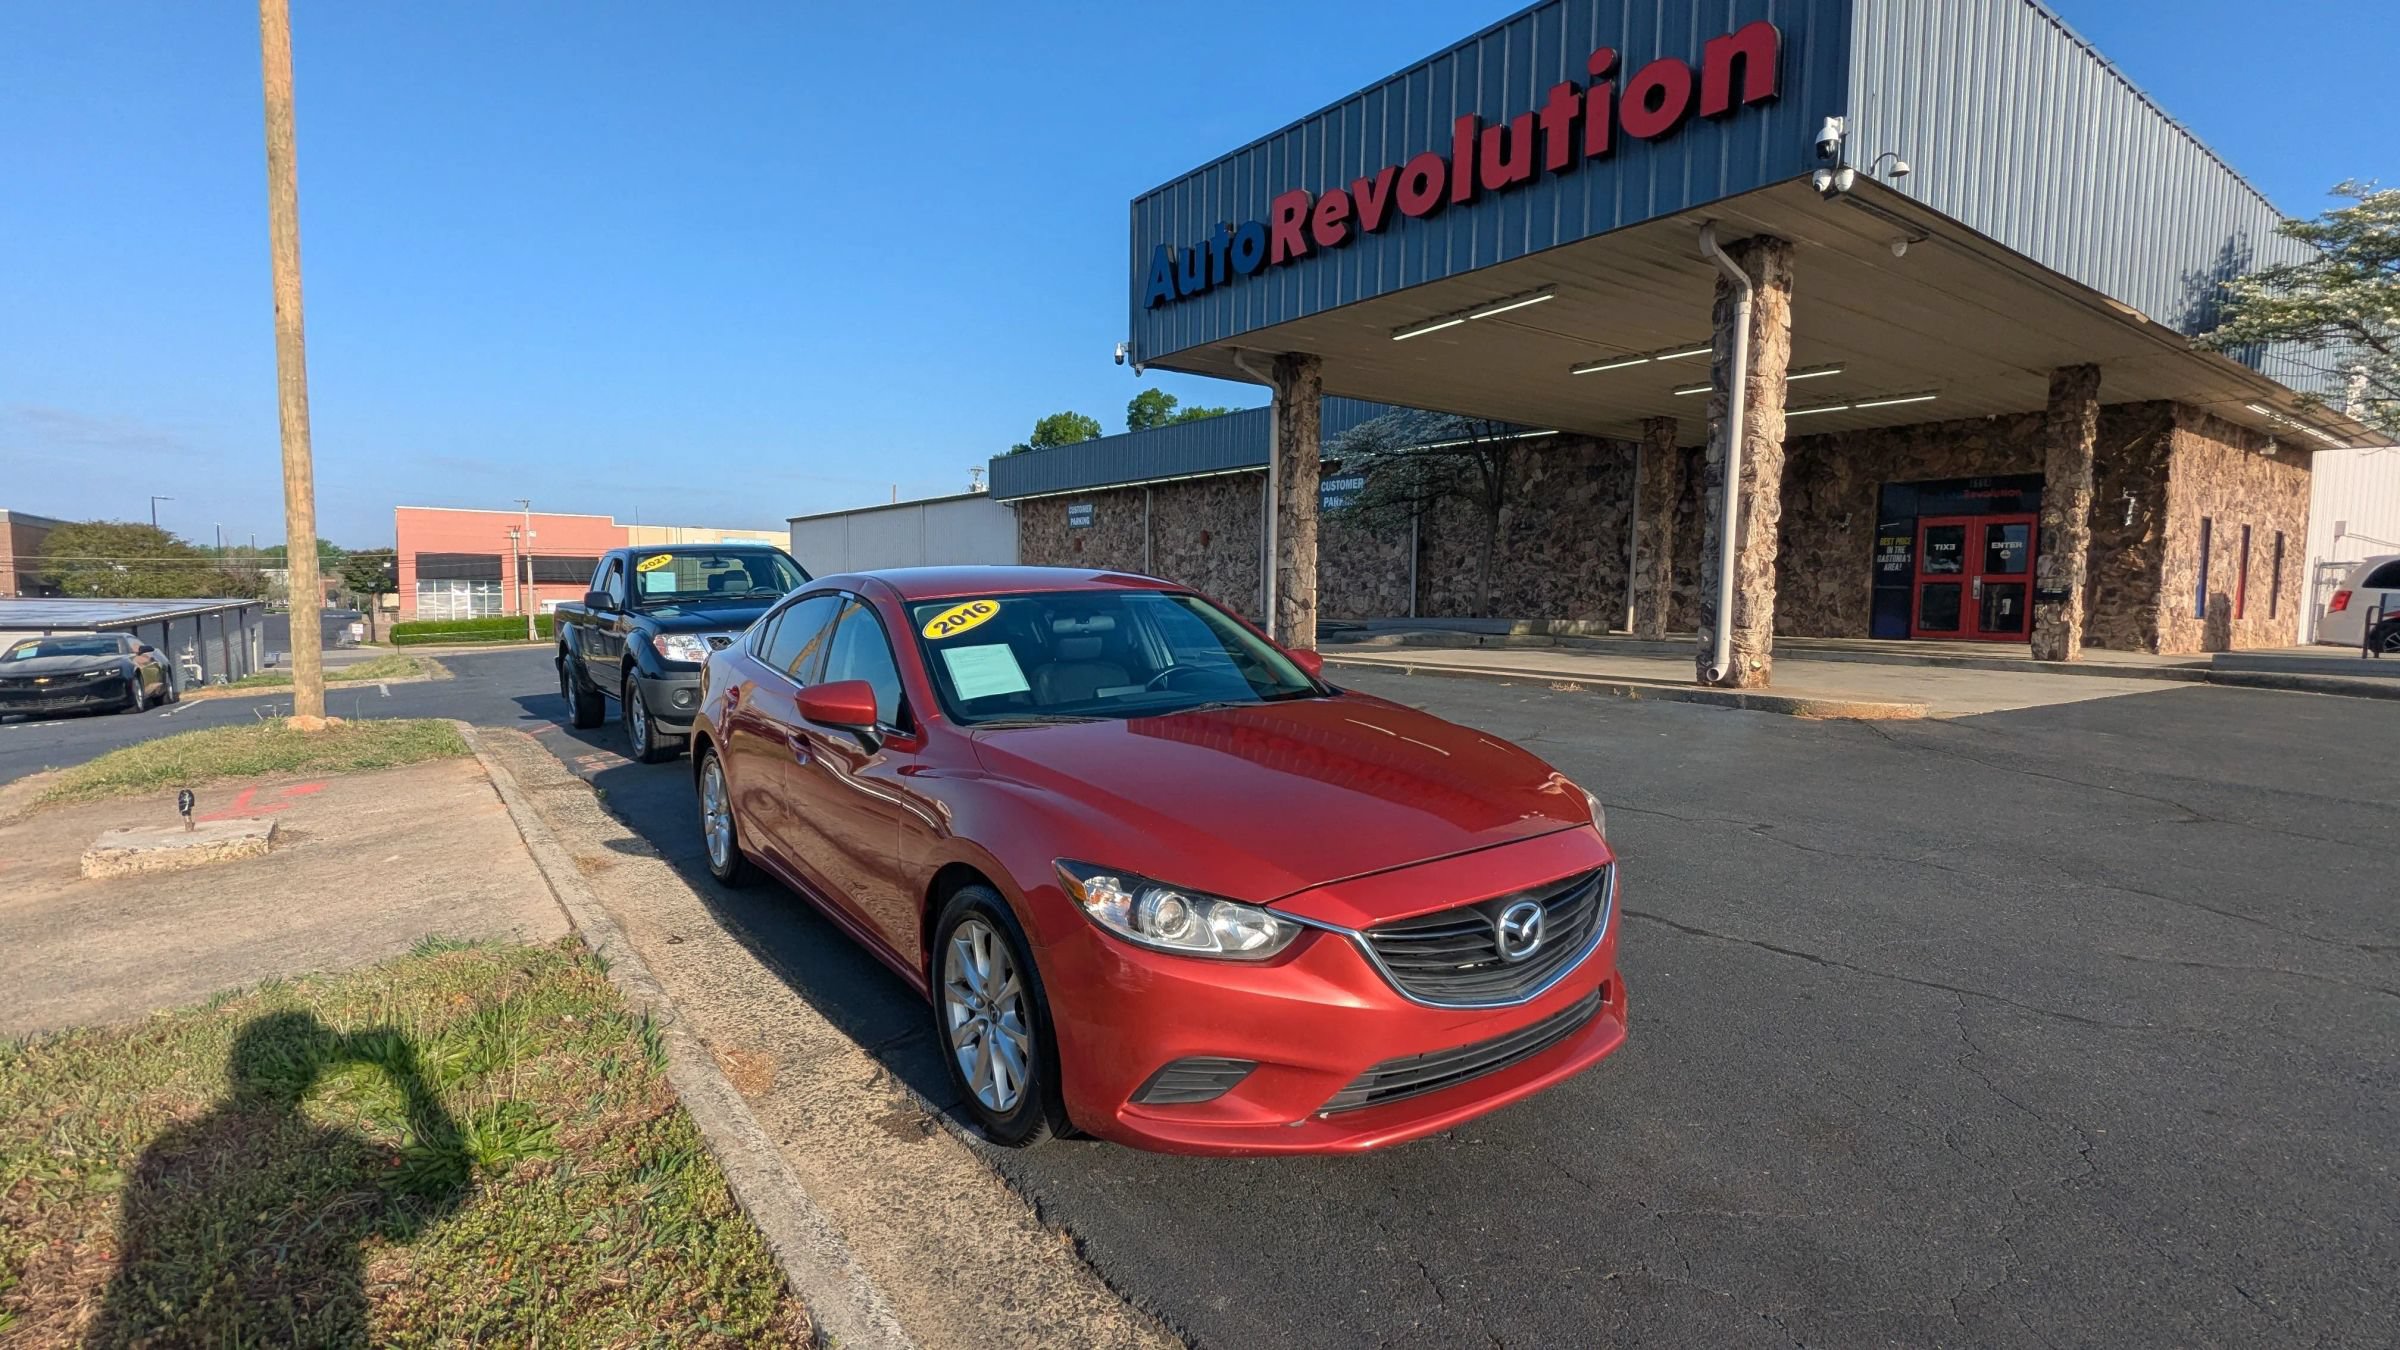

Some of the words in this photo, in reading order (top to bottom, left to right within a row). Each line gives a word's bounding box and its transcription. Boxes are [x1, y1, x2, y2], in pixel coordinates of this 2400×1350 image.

[1321, 477, 1364, 492] CUSTOMER
[1068, 504, 1092, 514] CUSTOMER
[1070, 516, 1090, 526] PARKING
[1991, 541, 2023, 549] ENTER
[641, 555, 669, 570] 2021
[933, 602, 991, 635] 2016
